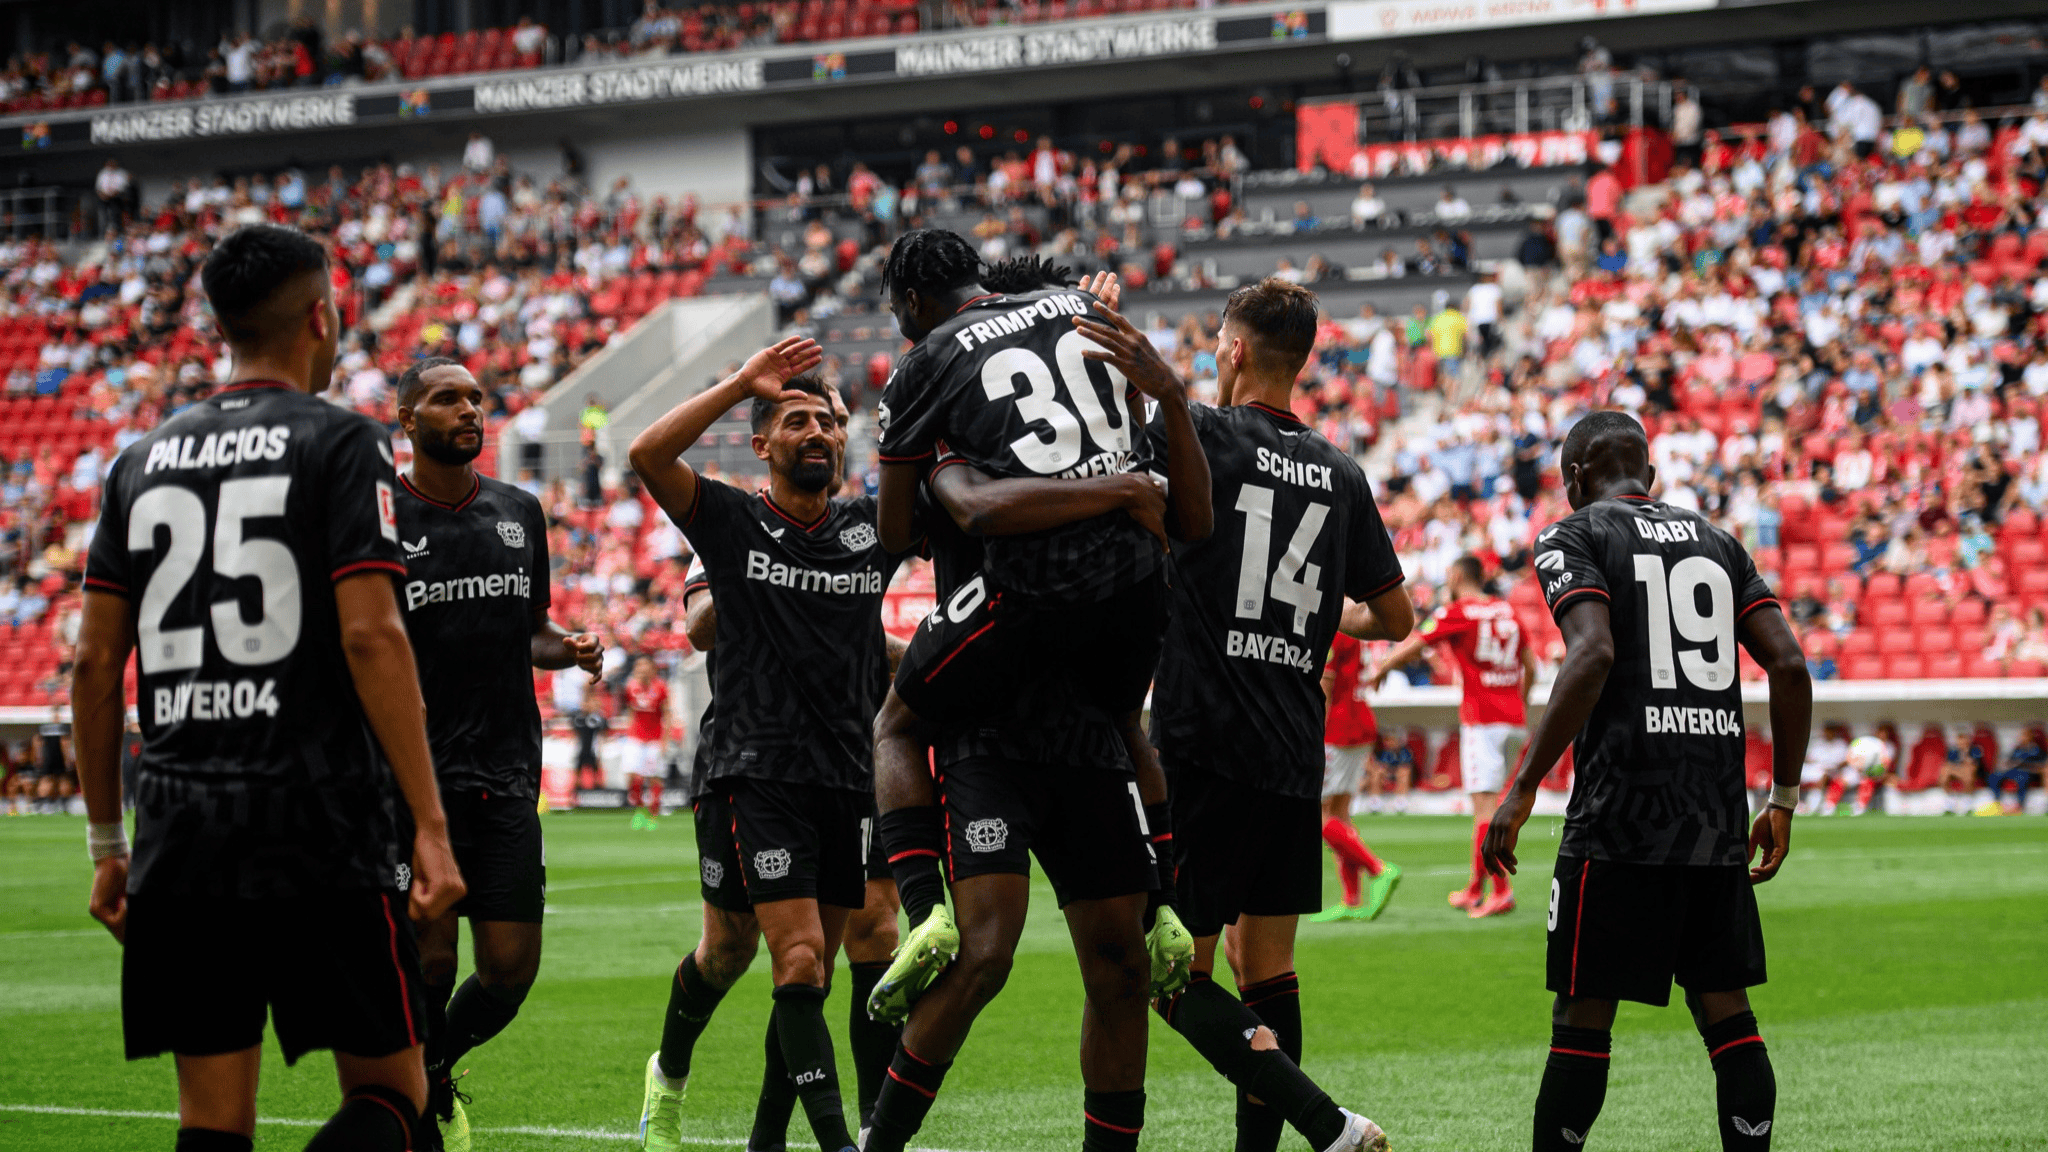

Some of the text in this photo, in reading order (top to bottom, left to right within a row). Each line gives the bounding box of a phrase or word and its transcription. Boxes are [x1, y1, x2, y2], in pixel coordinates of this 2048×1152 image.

[896, 18, 1217, 76] MAINZER STADTWERKE
[475, 58, 761, 113] MAINZER STADTWERKE
[91, 95, 354, 144] MAINZER STADTWERKE
[955, 294, 1088, 352] FRIMPONG
[981, 329, 1132, 474] 30
[144, 426, 290, 475] PALACIOS
[1256, 446, 1333, 493] SCHICK
[1634, 516, 1699, 544] DIABY
[128, 475, 301, 675] 25
[747, 550, 882, 595] Barmenia
[1235, 483, 1331, 637] 14
[405, 567, 530, 612] Barmenia
[946, 571, 986, 624] 0
[1633, 553, 1737, 691] 19
[1645, 705, 1741, 738] BAYER04
[860, 816, 873, 866] 1
[796, 1068, 826, 1086] B04
